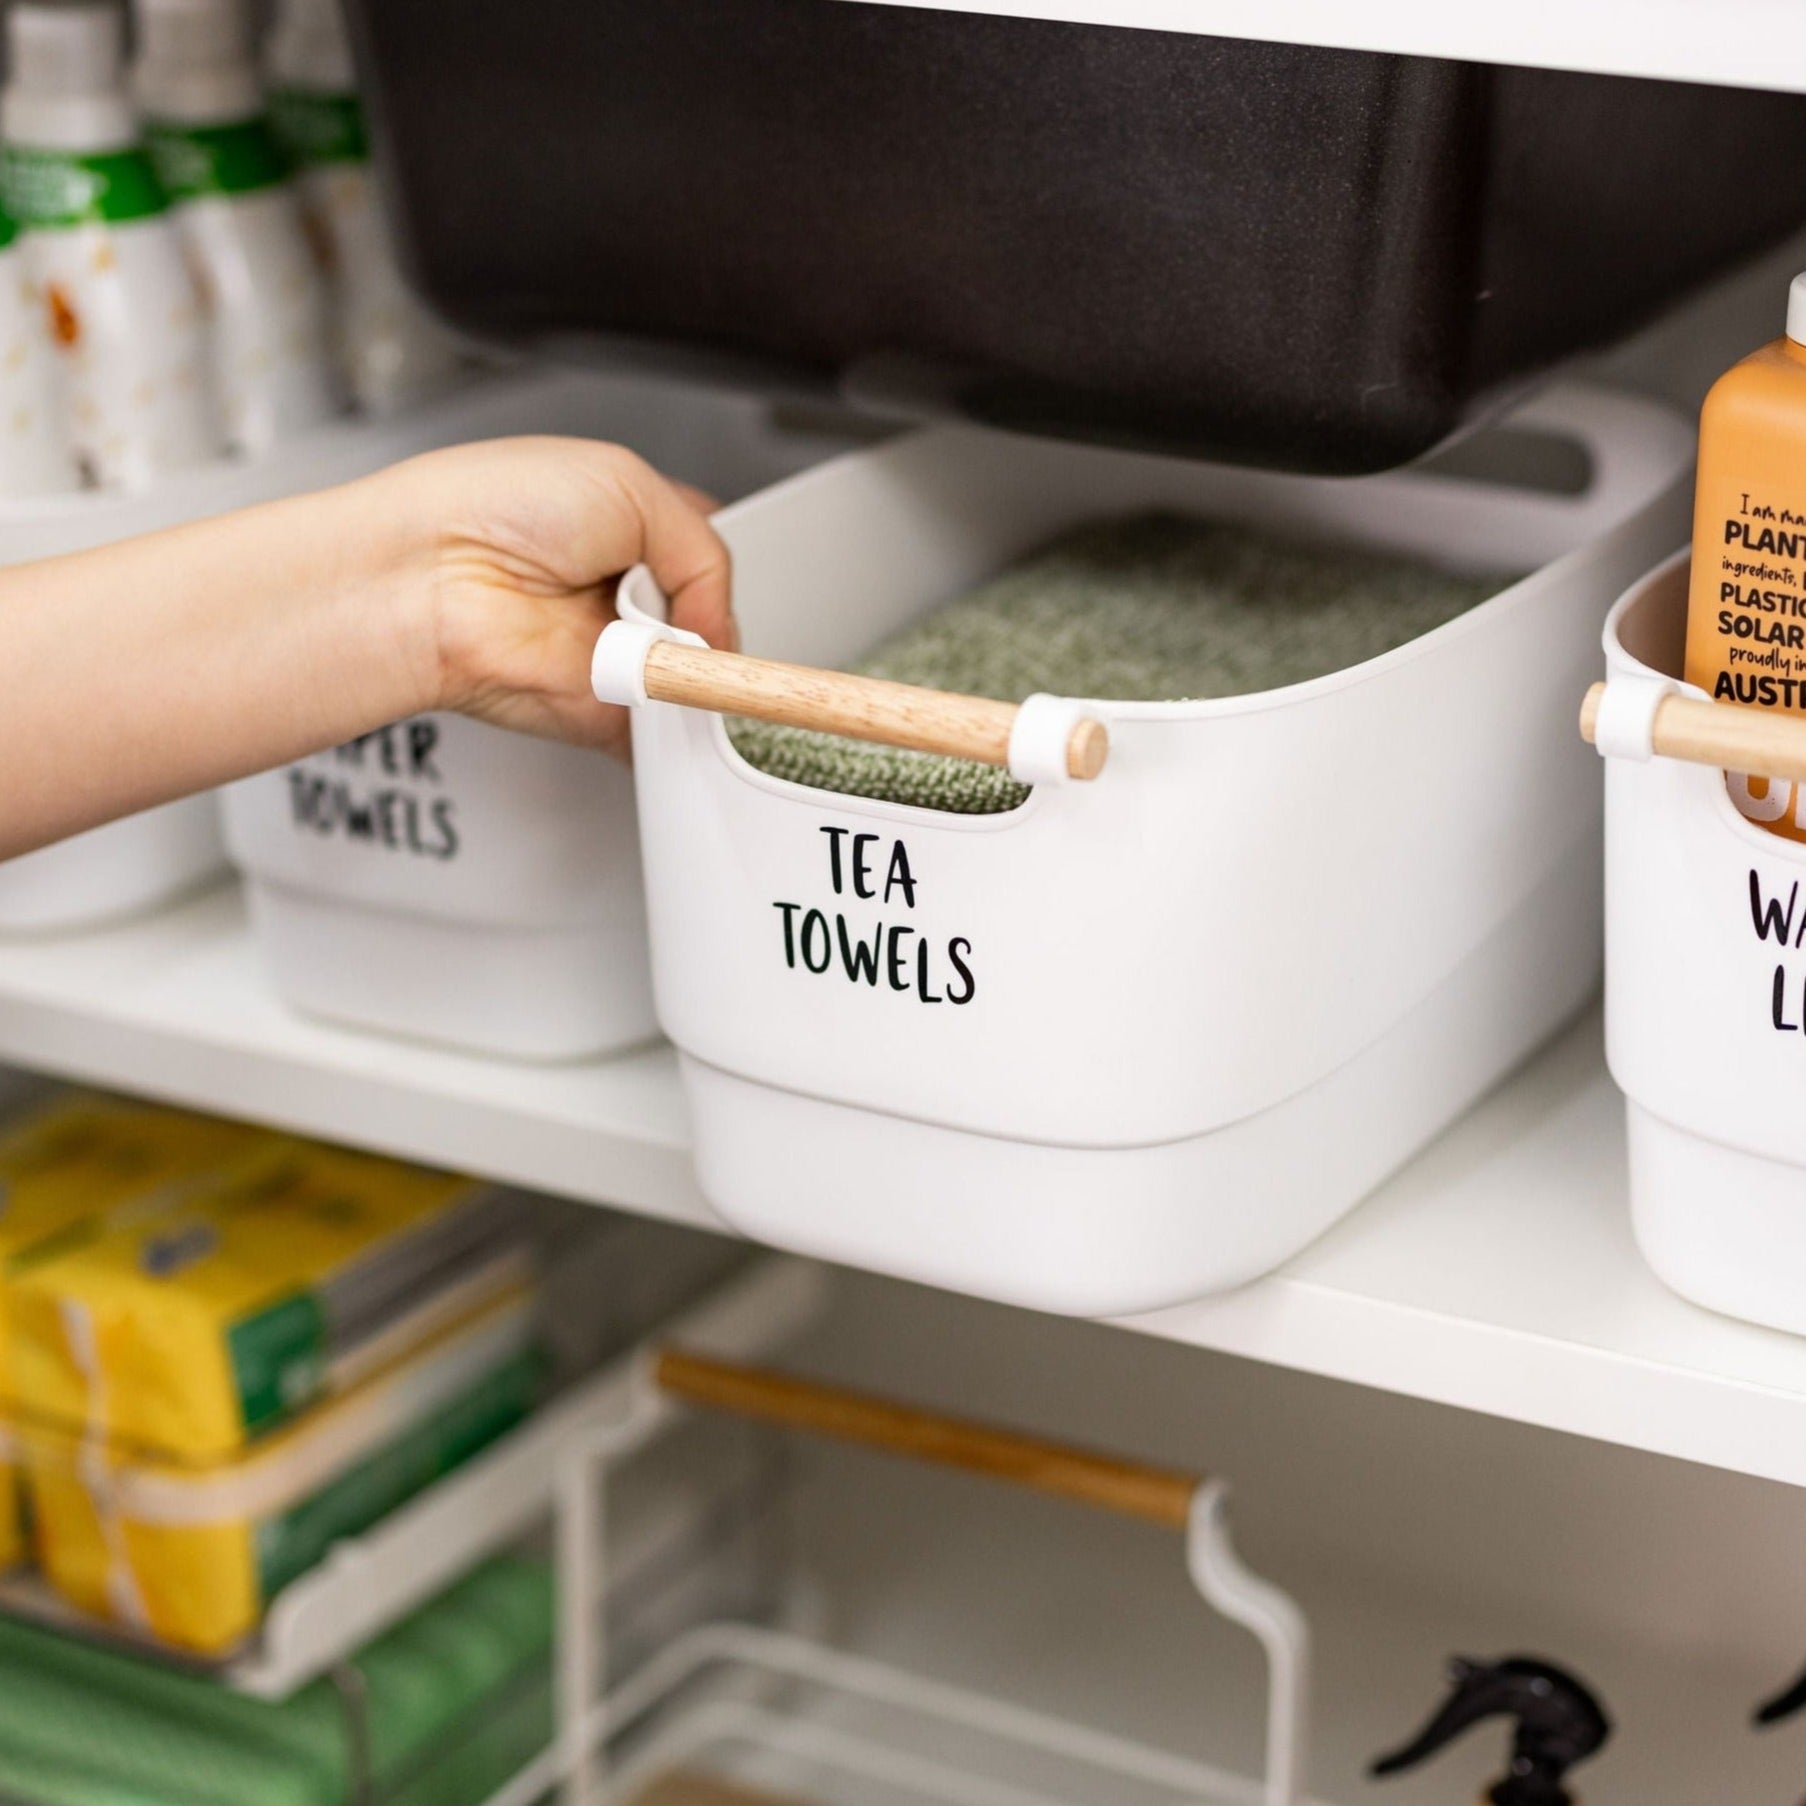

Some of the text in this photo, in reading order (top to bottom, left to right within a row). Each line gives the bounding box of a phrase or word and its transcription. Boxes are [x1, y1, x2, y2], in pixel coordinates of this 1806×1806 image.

[1740, 493, 1750, 515] I
[1752, 505, 1776, 521] am
[1722, 555, 1797, 588] ingredients,
[1717, 610, 1805, 650] SOLAR
[1729, 646, 1791, 678] proudly
[819, 826, 918, 909] TEA
[772, 901, 976, 1006] TOWELS
